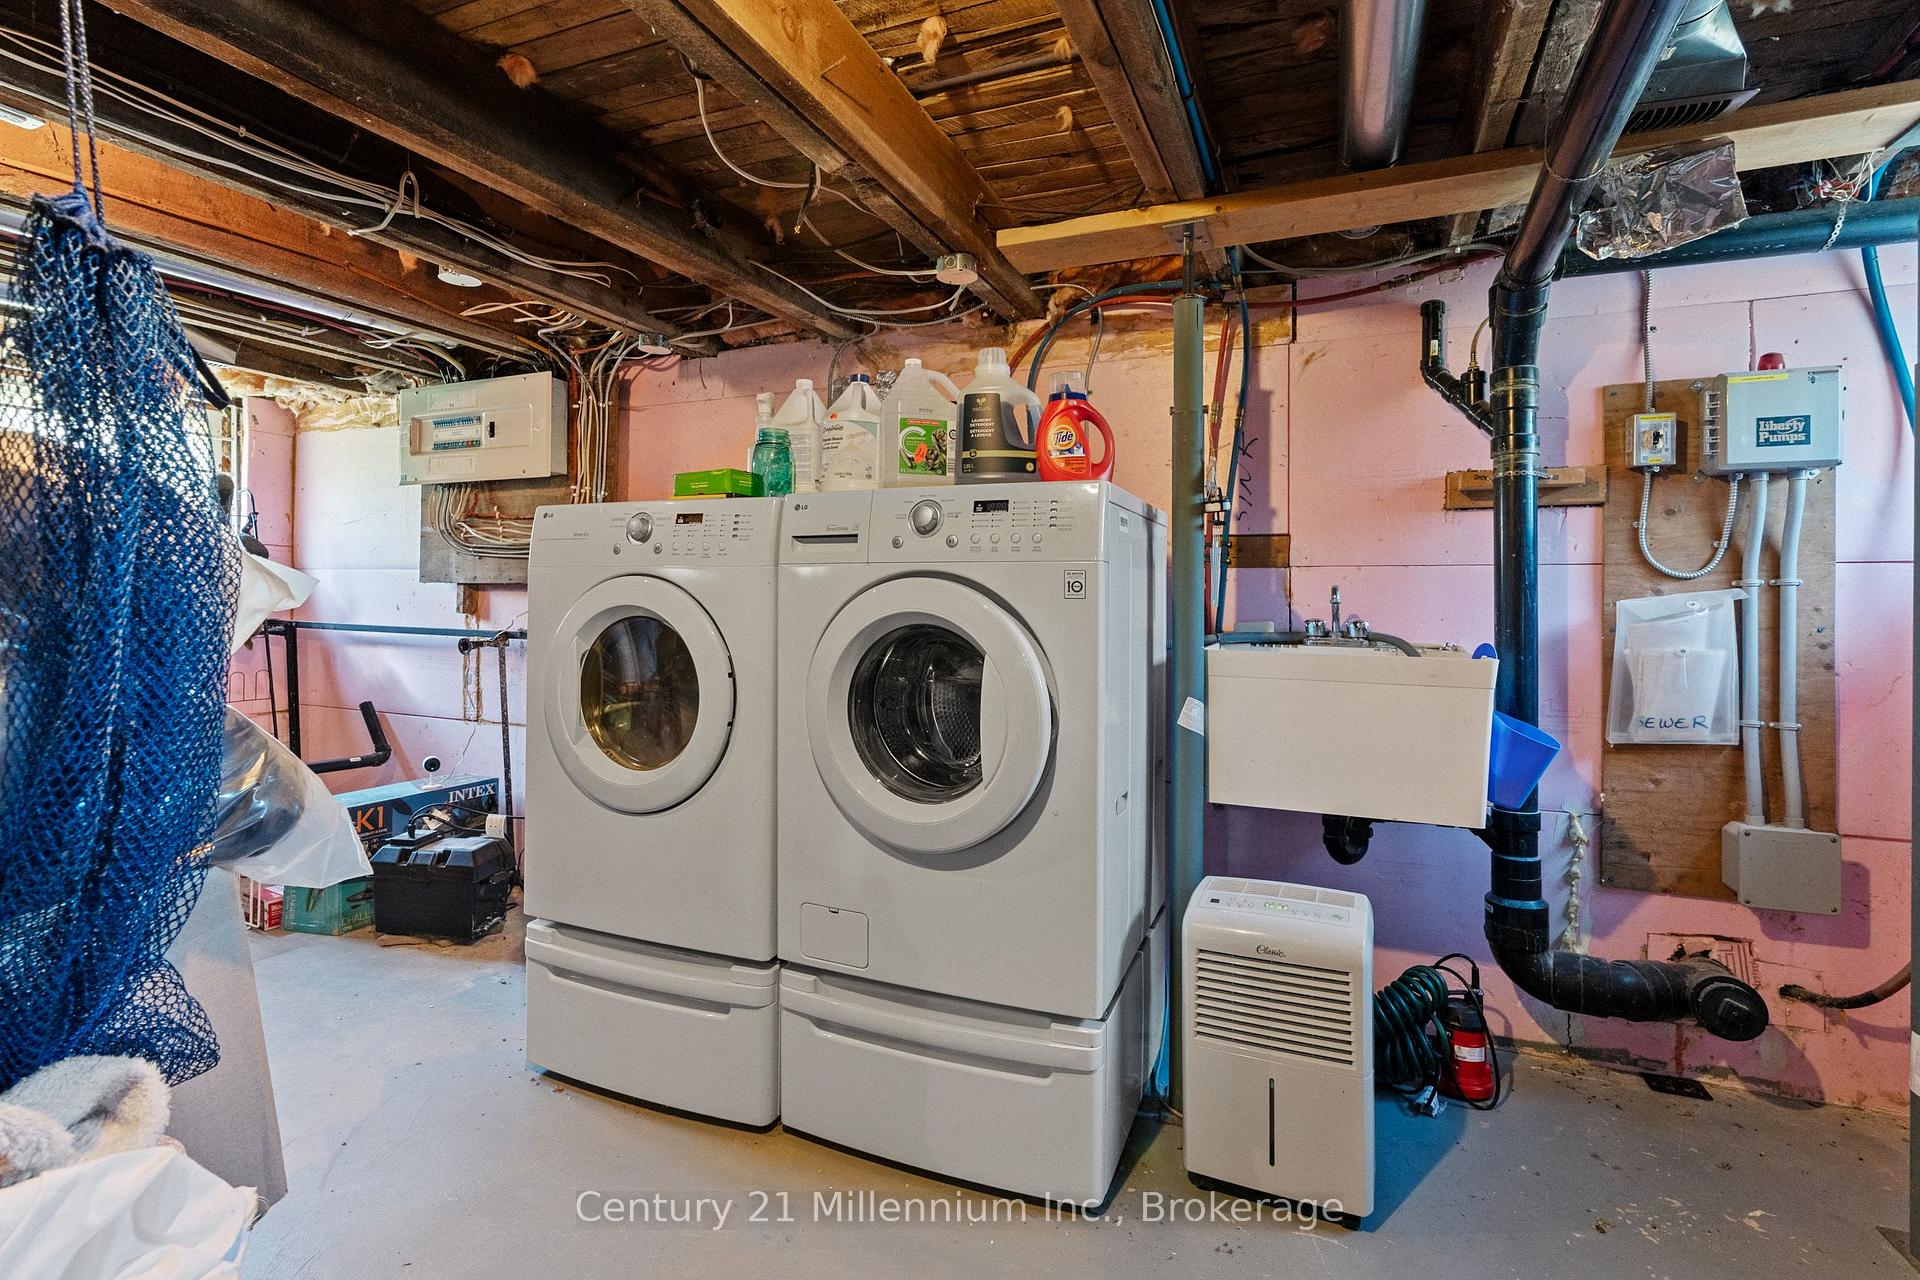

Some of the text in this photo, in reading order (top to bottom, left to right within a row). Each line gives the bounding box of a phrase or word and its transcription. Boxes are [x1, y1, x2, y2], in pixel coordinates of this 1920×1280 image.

[1758, 420, 1805, 432] Liberty
[1054, 430, 1074, 445] Tide
[1758, 432, 1806, 443] Pumps
[1236, 430, 1259, 521] SINK
[448, 783, 496, 804] INTEX
[357, 805, 385, 834] K1
[1256, 944, 1284, 958] Classic
